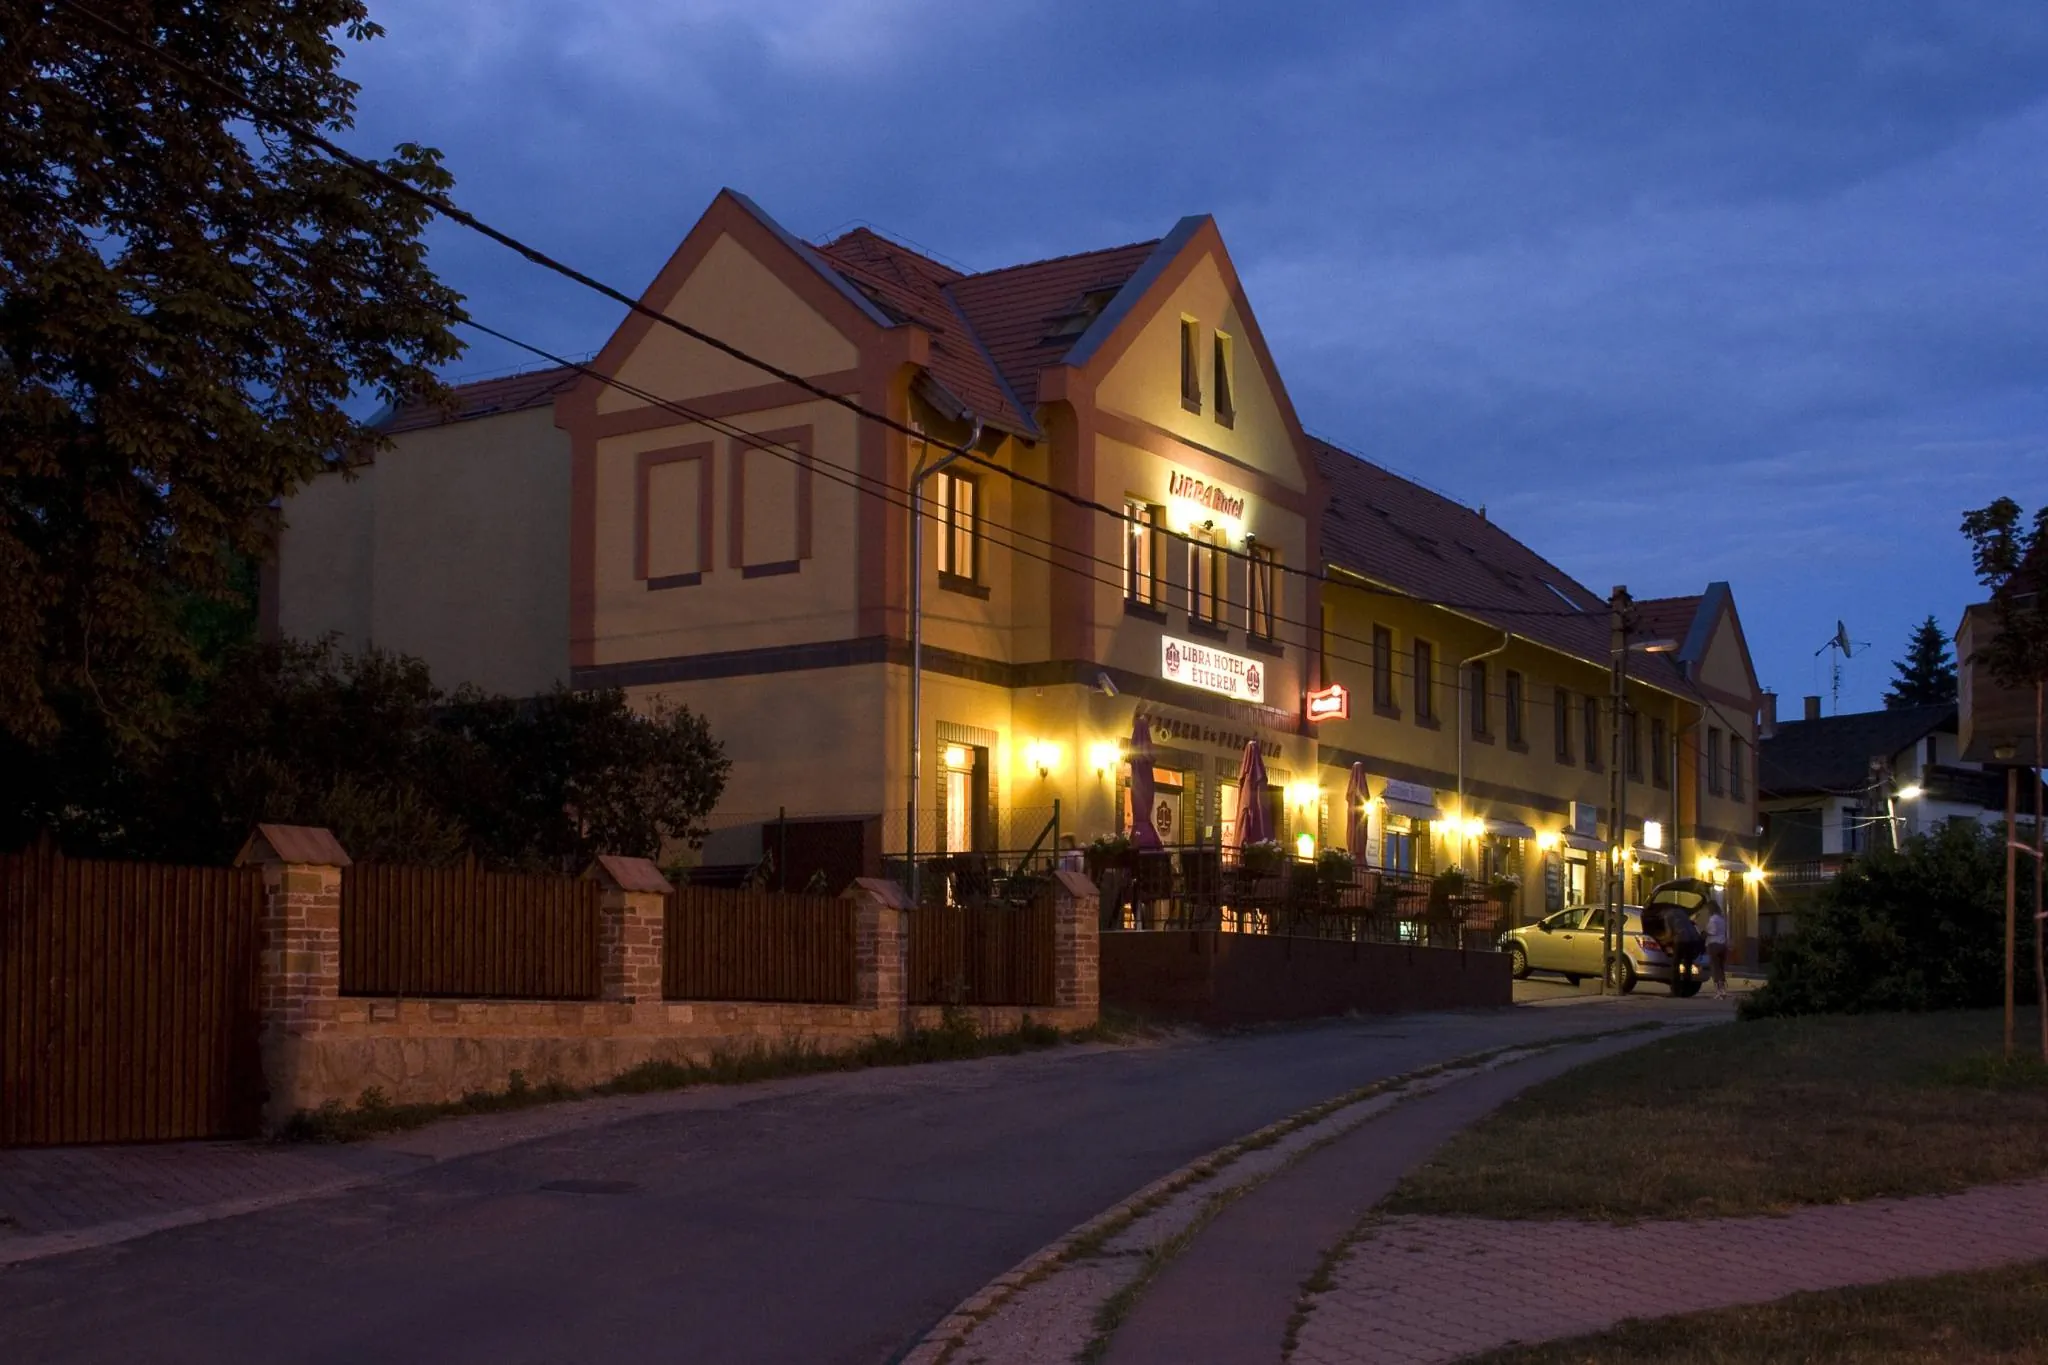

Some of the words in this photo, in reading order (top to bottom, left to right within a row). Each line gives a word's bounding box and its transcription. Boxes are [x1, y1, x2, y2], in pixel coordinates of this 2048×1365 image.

[1212, 487, 1244, 520] Hotel
[1182, 645, 1212, 667] LIBRA
[1214, 654, 1245, 676] HOTEL
[1192, 663, 1237, 692] ÉTTEREM
